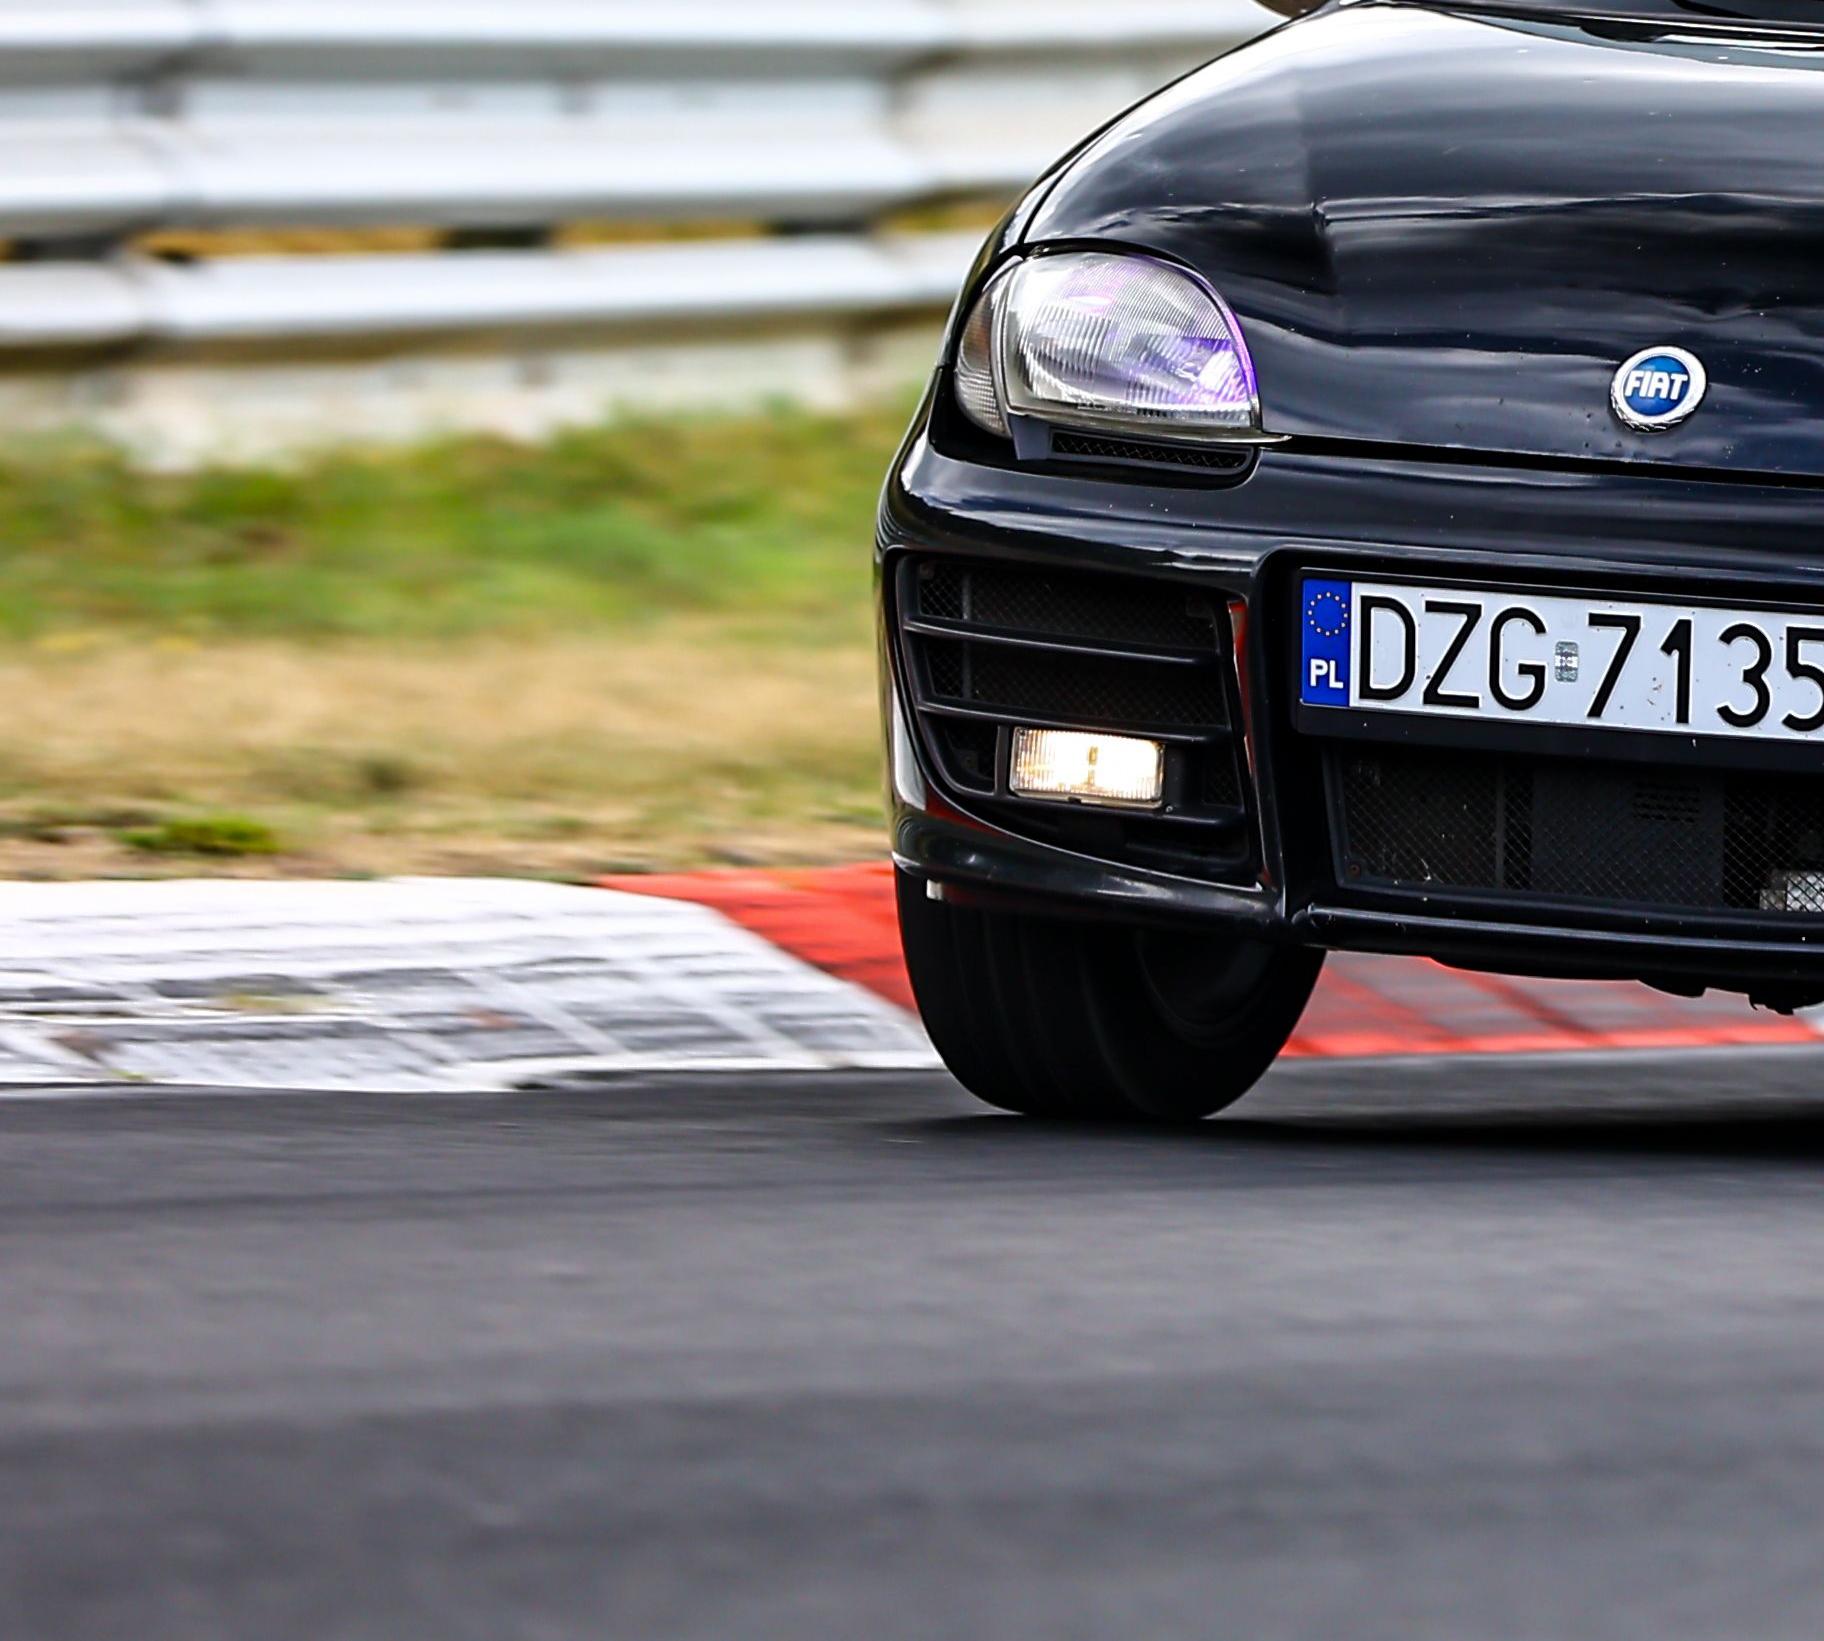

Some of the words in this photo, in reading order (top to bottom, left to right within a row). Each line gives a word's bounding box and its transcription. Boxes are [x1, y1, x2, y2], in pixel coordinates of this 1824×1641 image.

[1624, 369, 1689, 400] FIAT
[1358, 595, 1548, 712] DZG
[1310, 658, 1344, 689] PL
